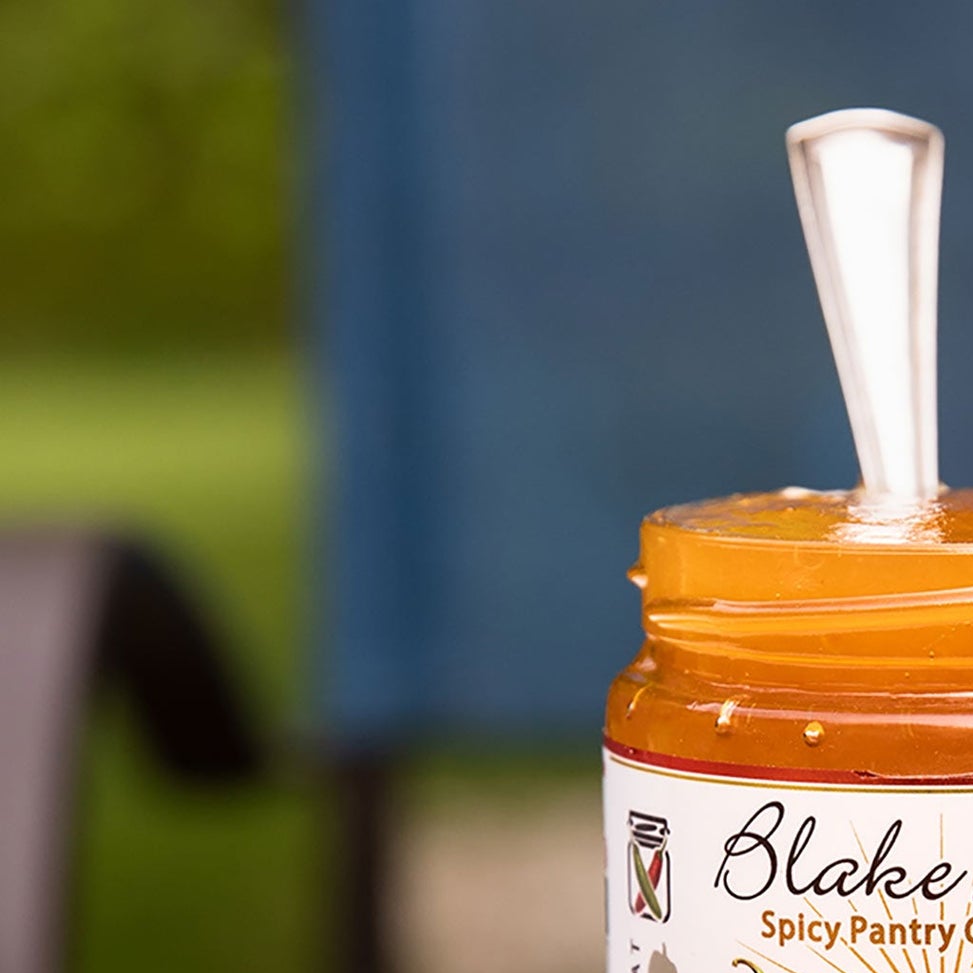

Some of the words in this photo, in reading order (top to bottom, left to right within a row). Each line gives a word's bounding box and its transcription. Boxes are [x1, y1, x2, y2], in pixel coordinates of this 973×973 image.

[714, 800, 968, 901] Blake
[761, 910, 842, 950] Spicy
[850, 916, 957, 952] Pantry
